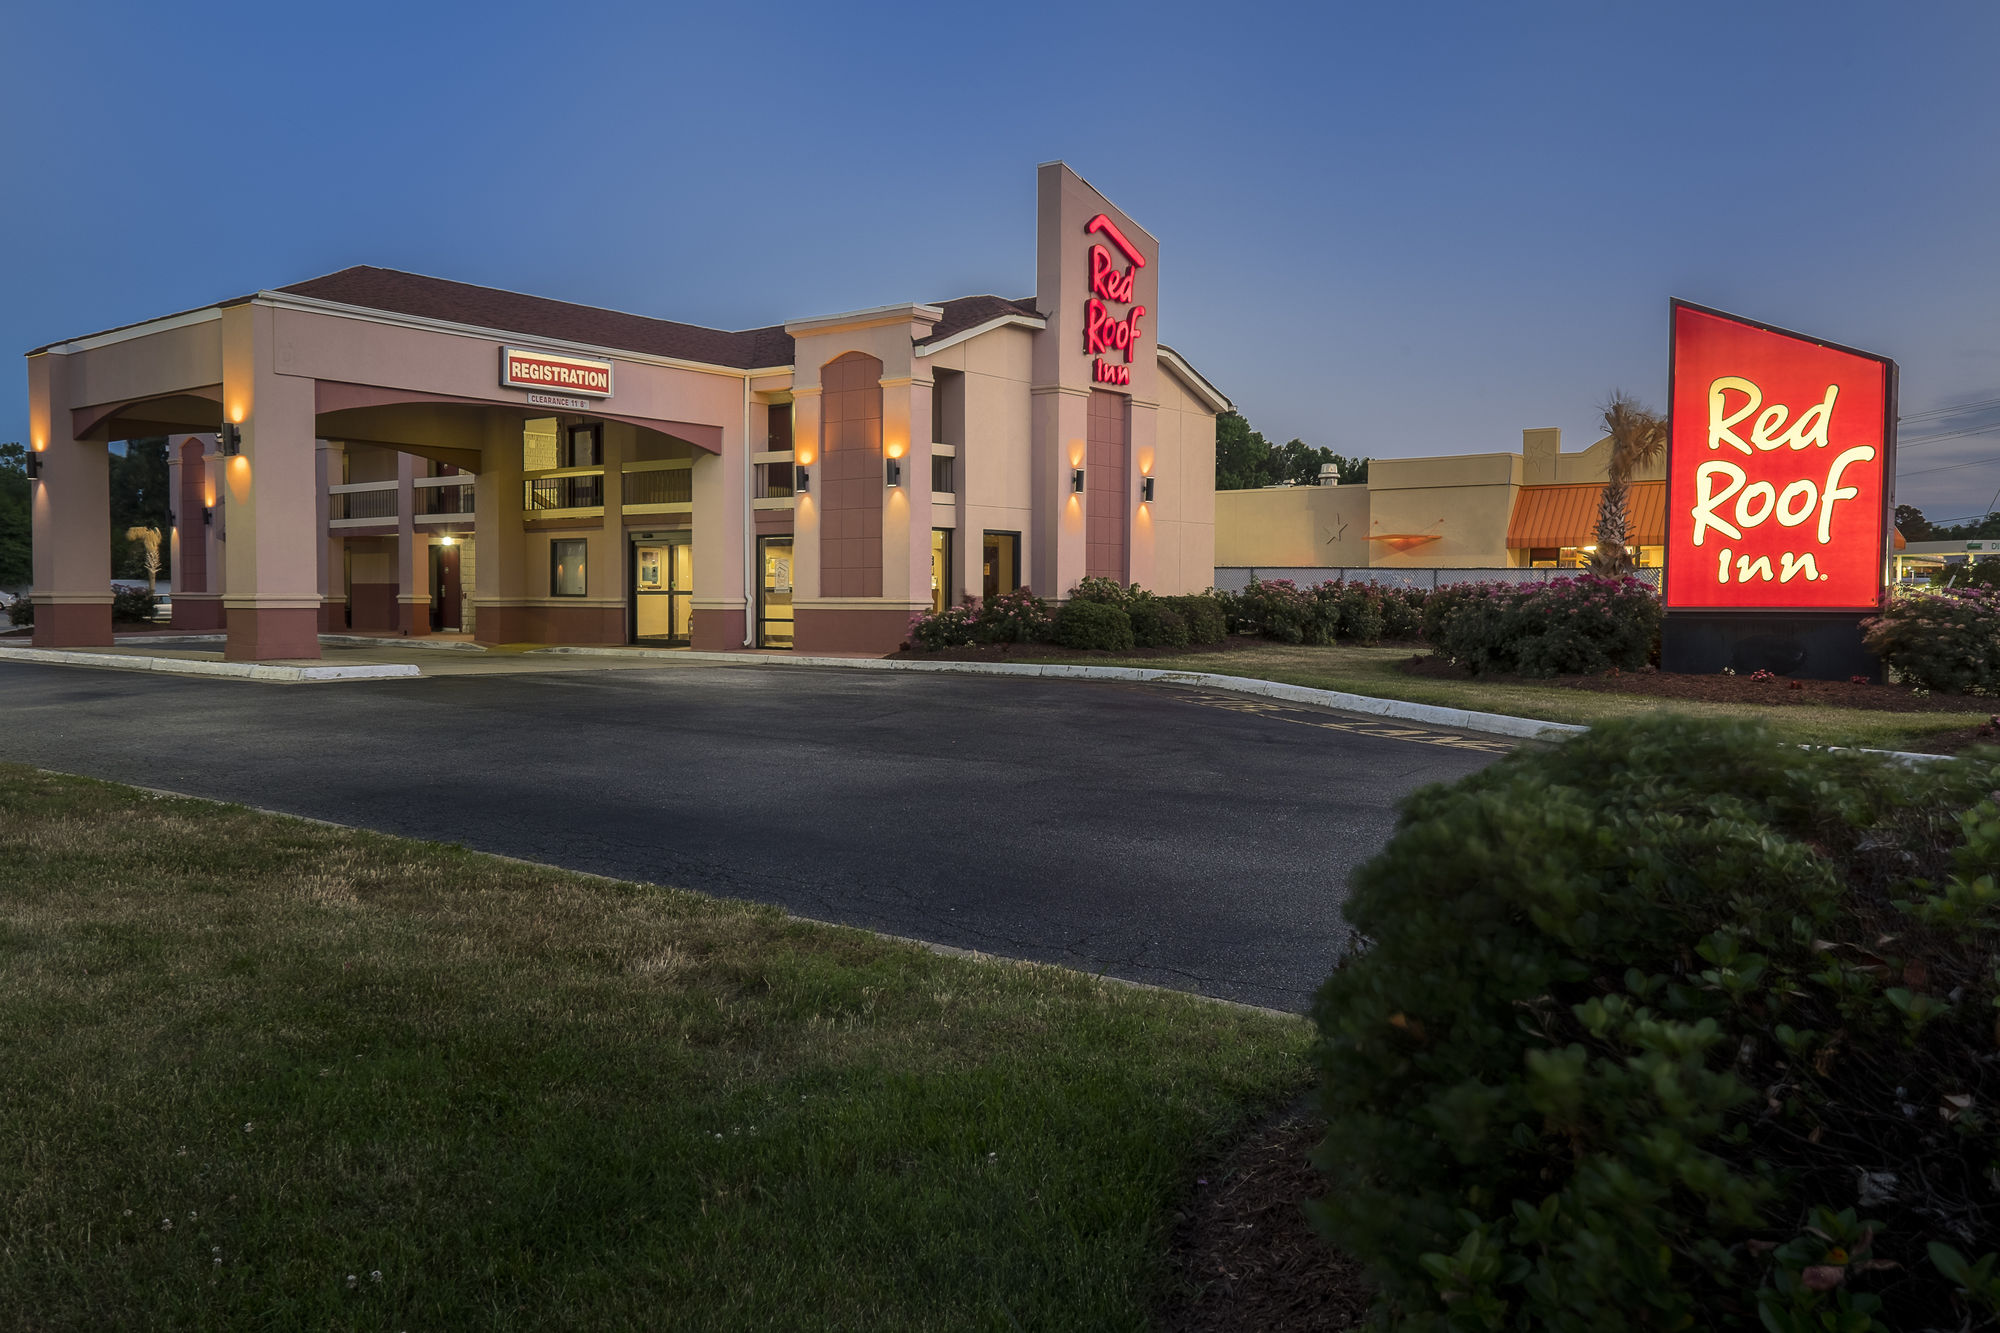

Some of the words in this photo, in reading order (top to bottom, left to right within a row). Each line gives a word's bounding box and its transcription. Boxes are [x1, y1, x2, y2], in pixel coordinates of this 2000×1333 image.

[1089, 244, 1136, 304] Red
[1085, 298, 1146, 363] Roof
[511, 361, 607, 388] REGISTRATION
[531, 395, 569, 407] CLEARANCE
[1093, 357, 1130, 386] Inn
[1708, 376, 1839, 456] Red
[1691, 445, 1876, 547] Roof
